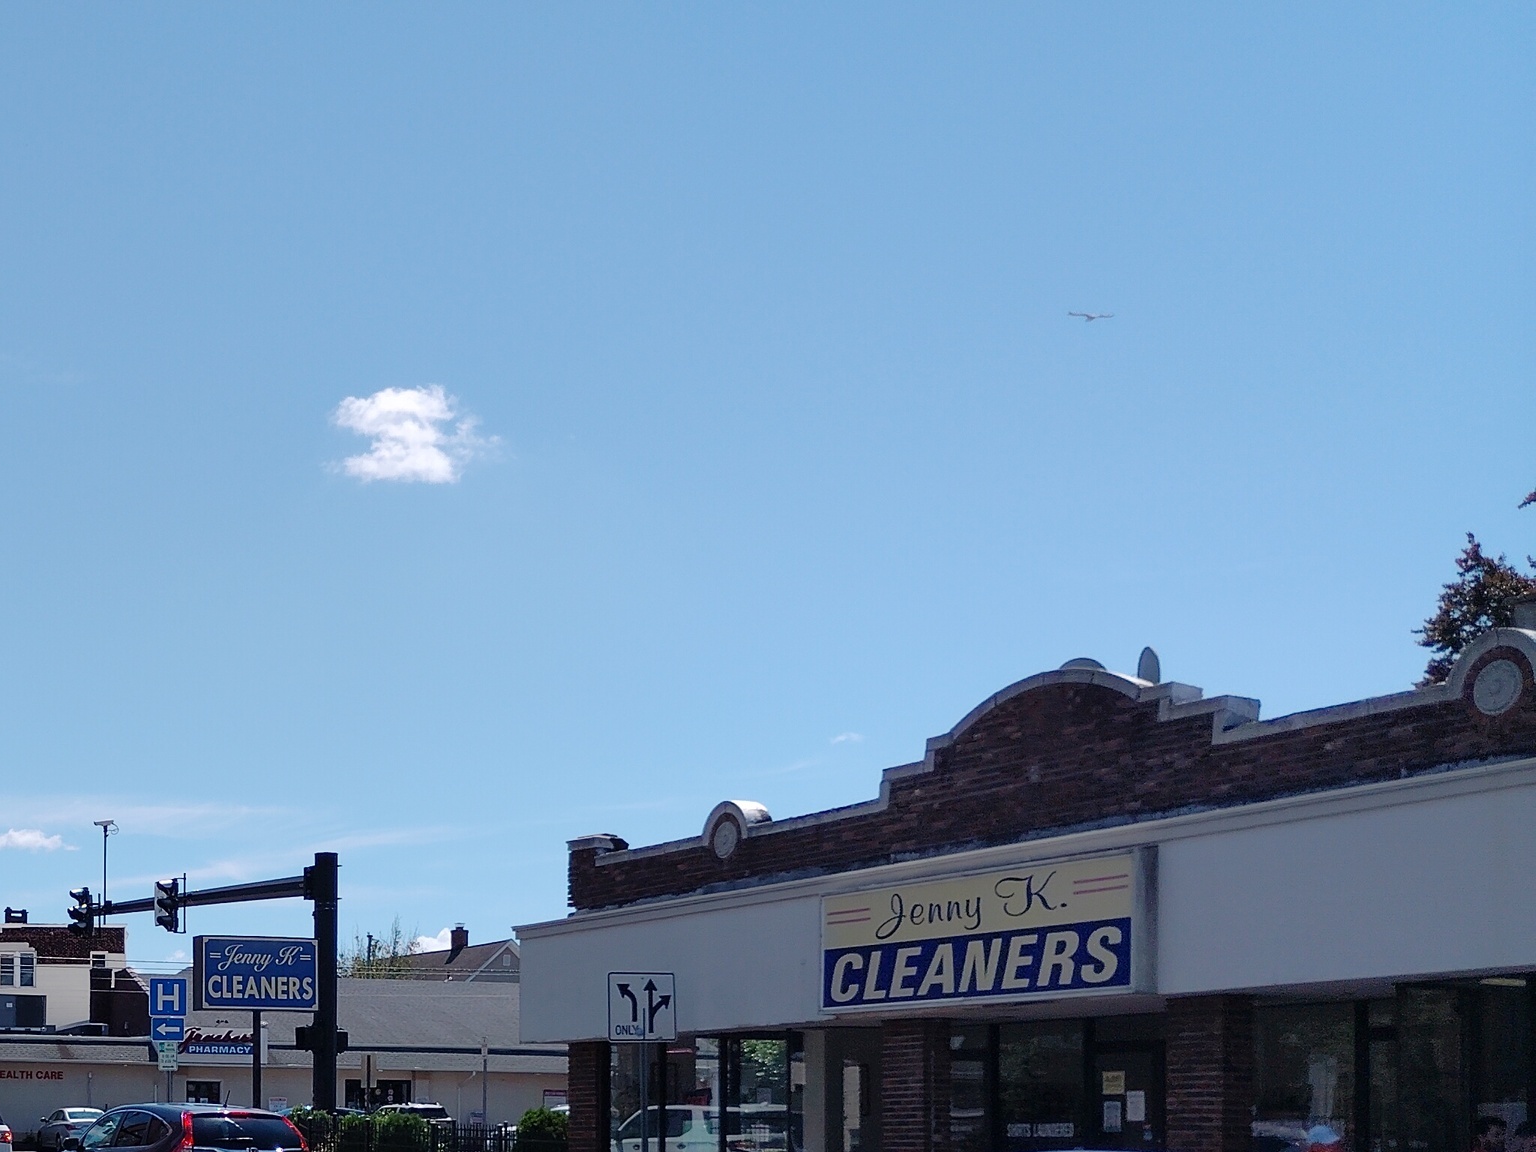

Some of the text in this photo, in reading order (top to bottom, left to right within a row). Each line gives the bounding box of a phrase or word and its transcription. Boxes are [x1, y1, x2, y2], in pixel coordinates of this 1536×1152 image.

[875, 893, 982, 940] Jenny
[218, 944, 304, 972] Jenny K
[830, 925, 1123, 1004] CLEANERS
[157, 983, 180, 1011] H
[207, 975, 314, 1000] CLEANERS
[615, 1024, 639, 1036] ONLY
[189, 1045, 251, 1054] PHARMACY
[35, 1070, 64, 1080] CARE
